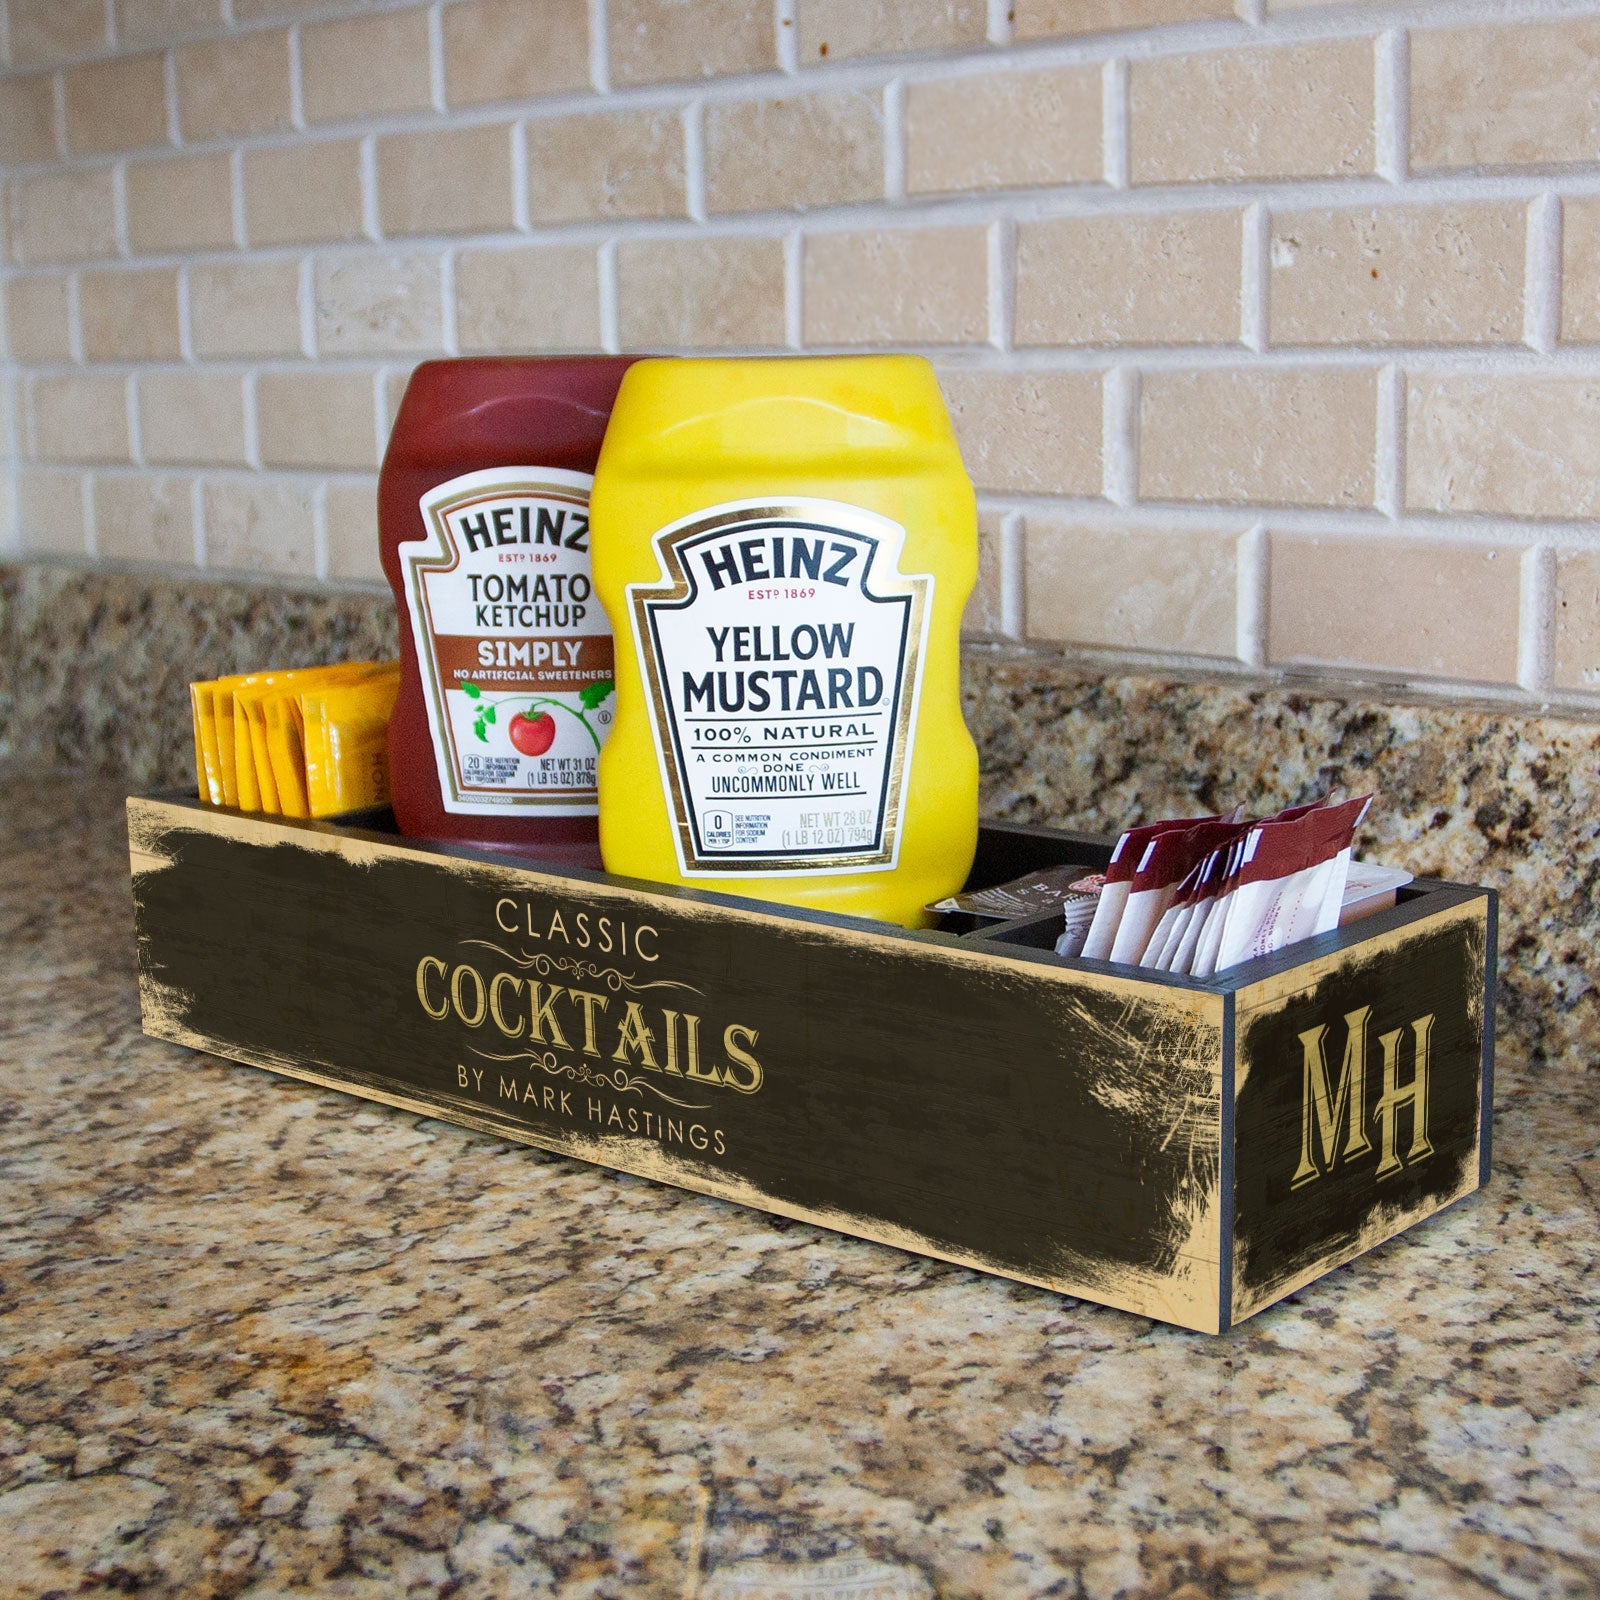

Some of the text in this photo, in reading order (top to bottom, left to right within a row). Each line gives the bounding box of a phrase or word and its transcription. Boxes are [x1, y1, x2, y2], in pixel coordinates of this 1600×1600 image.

[459, 507, 589, 553] HEINZ
[530, 554, 557, 562] 1869
[700, 537, 858, 591] HEINZ
[466, 573, 590, 602] TOMATO
[784, 588, 816, 599] 1869
[476, 605, 586, 627] KETCHUP
[705, 622, 855, 662] YELLOW
[477, 640, 583, 667] SIMPLY
[453, 669, 612, 681] NO ARTIFICIAL SWEETENERS
[682, 666, 884, 713] MUSTARD
[694, 723, 875, 743] 100% NATURAL
[468, 757, 480, 769] 20
[540, 757, 595, 770] NET WT 31 OZ
[696, 748, 875, 763] A COMMON CONDIMENT
[527, 771, 534, 787] (1
[537, 772, 547, 784] LB
[550, 772, 558, 784] 15
[560, 771, 574, 786] OZ)
[763, 763, 804, 773] DONE
[712, 771, 861, 793] UNCOMMONLY WELL
[800, 813, 820, 828] NET
[823, 811, 840, 828] WT
[860, 809, 872, 824] OZ
[781, 829, 790, 849] (1
[795, 830, 808, 845] LB
[812, 829, 824, 844] 12
[827, 827, 844, 846] OZ)
[495, 898, 659, 962] CLASSIC
[416, 956, 764, 1094] COCKTAILS
[1290, 1004, 1436, 1191] MH
[457, 1064, 726, 1156] BY MARK HASTINGS
